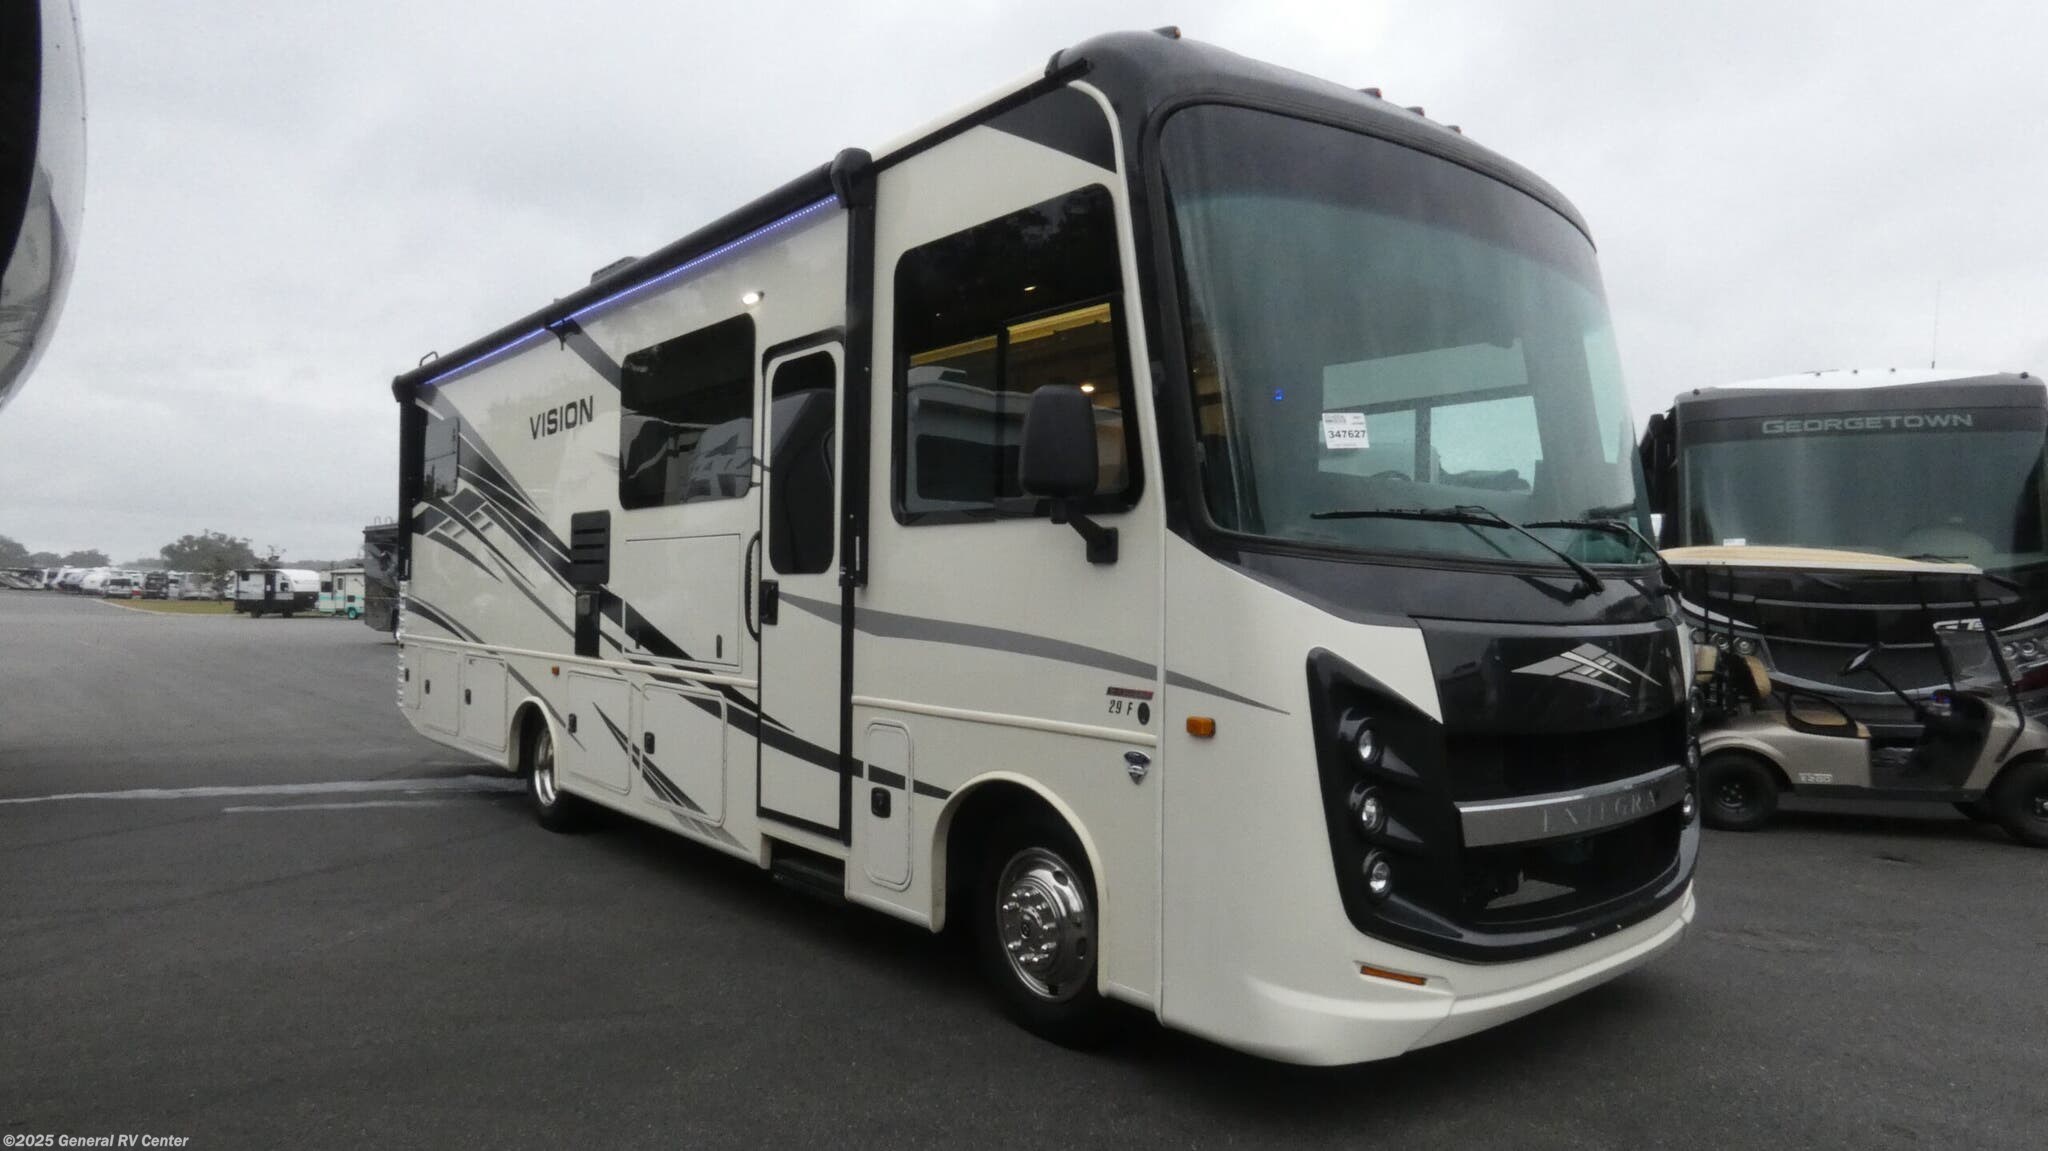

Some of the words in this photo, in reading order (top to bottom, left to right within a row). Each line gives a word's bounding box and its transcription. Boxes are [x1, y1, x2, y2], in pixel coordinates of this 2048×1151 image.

[529, 395, 593, 440] VISION
[1761, 413, 1974, 434] GEORGETOWN
[1328, 430, 1366, 439] 347627
[1108, 699, 1122, 714] 29
[1126, 702, 1134, 716] F
